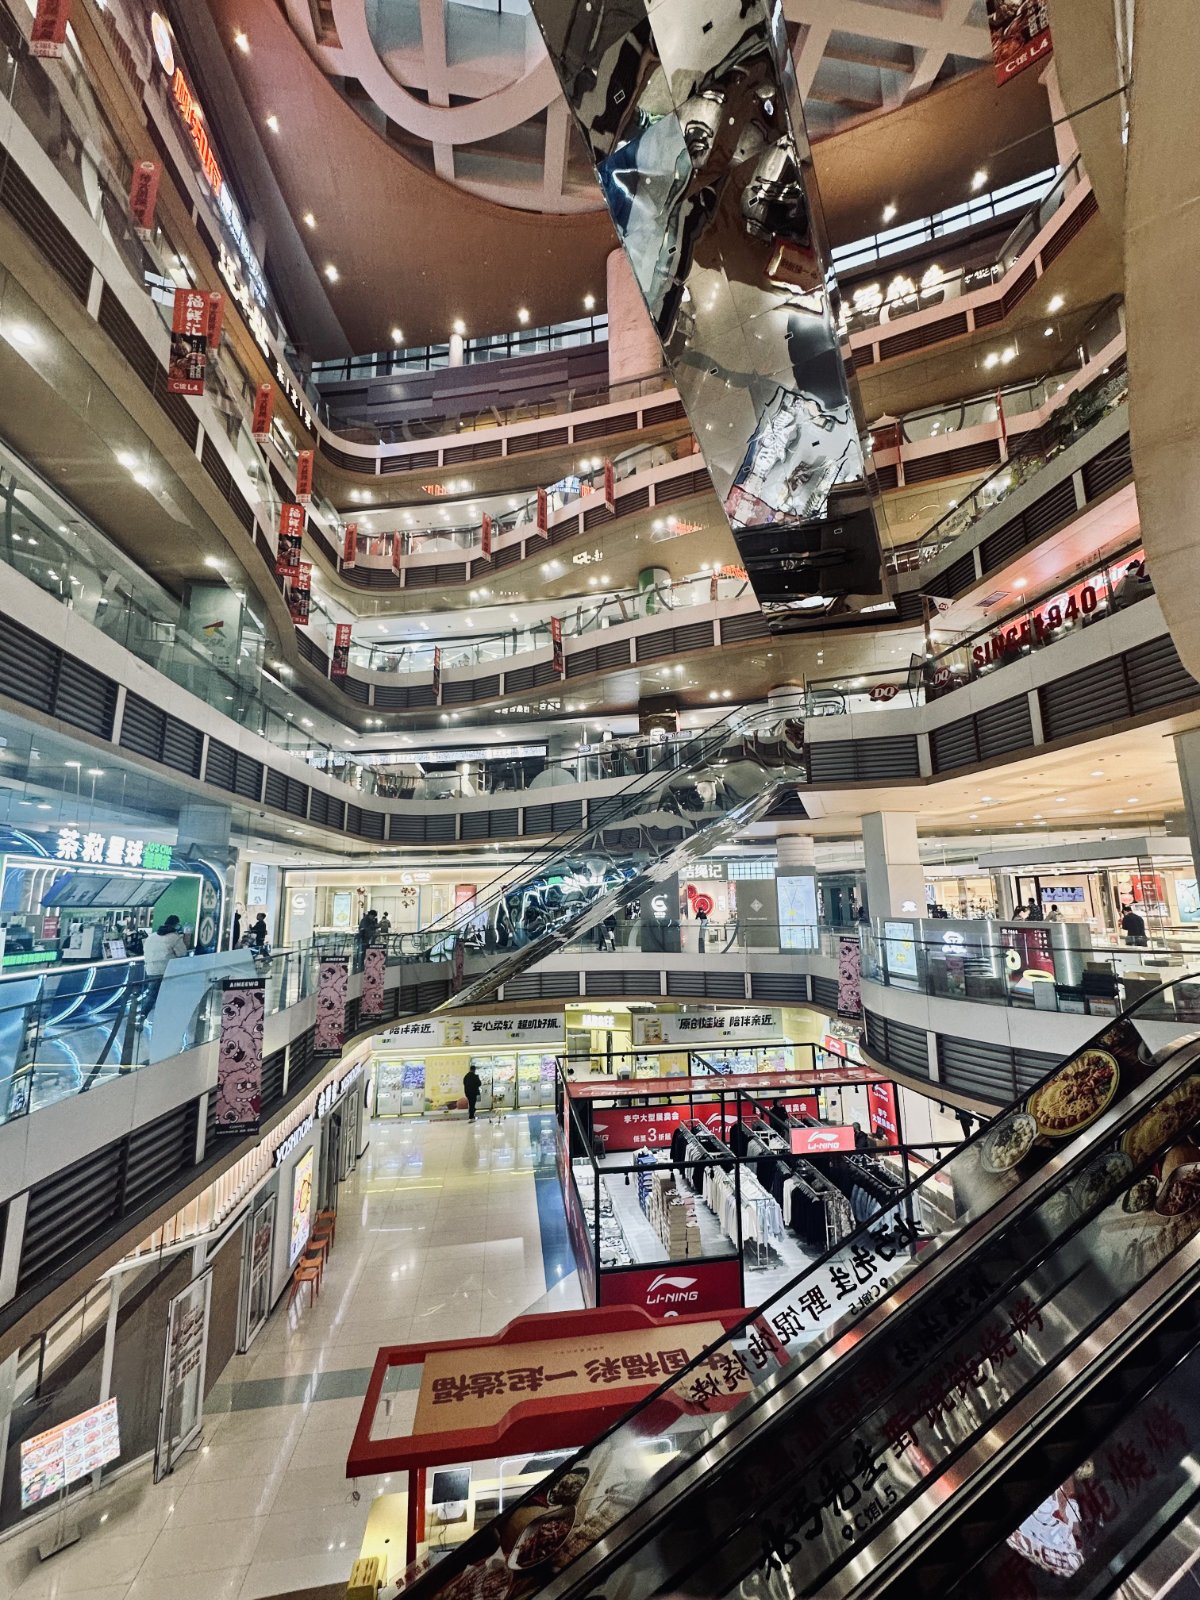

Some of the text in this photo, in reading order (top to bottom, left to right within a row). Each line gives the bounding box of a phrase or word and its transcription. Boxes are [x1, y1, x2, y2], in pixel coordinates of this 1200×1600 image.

[934, 669, 949, 684] DQ
[874, 686, 895, 698] DQ
[807, 1142, 840, 1150] LI-NING
[646, 1291, 699, 1305] LI-NING
